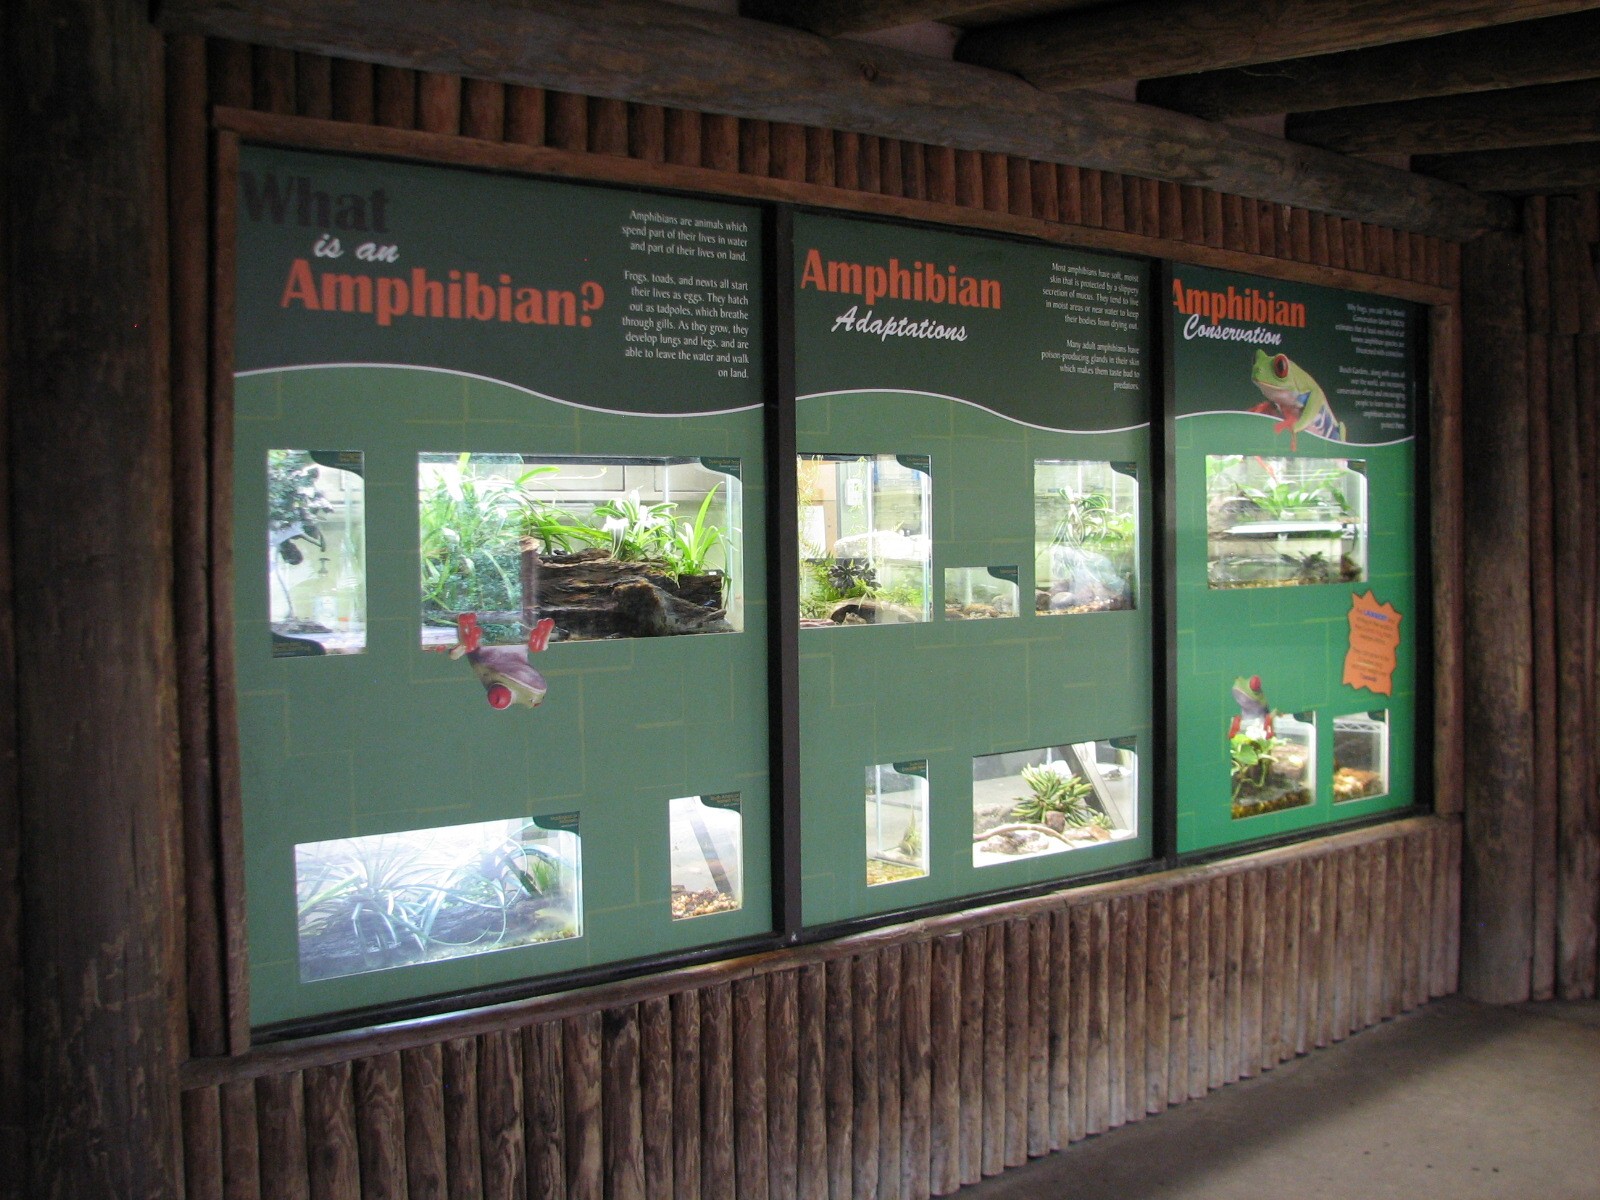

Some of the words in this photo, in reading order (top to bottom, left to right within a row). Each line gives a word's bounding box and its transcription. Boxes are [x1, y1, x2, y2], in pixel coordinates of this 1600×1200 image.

[239, 170, 389, 234] What
[630, 210, 677, 226] Amphibians
[695, 219, 723, 229] animals
[726, 223, 747, 232] which
[622, 226, 646, 237] spend
[649, 229, 665, 239] part
[667, 229, 675, 238] of
[678, 232, 696, 241] their
[699, 233, 715, 243] lives
[719, 235, 725, 243] in
[728, 238, 747, 246] water
[313, 234, 343, 259] is
[356, 241, 399, 263] an
[630, 242, 645, 251] and
[648, 244, 663, 254] part
[667, 245, 675, 253] of
[677, 247, 694, 255] their
[698, 248, 714, 258] lives
[717, 251, 726, 259] on
[729, 252, 747, 261] land.
[625, 271, 648, 284] Frogs,
[652, 274, 676, 285] toads,
[679, 276, 693, 285] and
[696, 279, 717, 288] newts
[720, 279, 728, 288] all
[731, 281, 748, 290] start
[801, 249, 1001, 309] Amphibian
[1052, 263, 1066, 271] Most
[1067, 266, 1097, 276] amphibians
[1098, 269, 1110, 278] have
[1124, 274, 1138, 282] moist
[280, 258, 604, 327] Amphibian?
[1050, 275, 1061, 283] skin
[1063, 277, 1073, 285] that
[1081, 280, 1105, 289] protected
[1107, 283, 1112, 293] by
[631, 287, 650, 297] their
[653, 288, 670, 298] lives
[684, 294, 704, 304] eggs.
[707, 293, 725, 305] They
[728, 296, 748, 305] hatch
[1043, 289, 1067, 297] secretion
[1097, 294, 1108, 305] They
[1173, 279, 1306, 327] Amphibian
[630, 303, 643, 312] out
[657, 305, 693, 316] tadpoles,
[695, 307, 718, 317] which
[720, 309, 748, 319] breathe
[1127, 310, 1139, 320] keep
[622, 317, 654, 328] through
[657, 320, 675, 331] gills.
[679, 321, 689, 330] As
[692, 322, 707, 332] they
[733, 325, 748, 336] they
[831, 306, 968, 341] Adaptations
[1065, 314, 1077, 322] their
[1079, 315, 1096, 325] bodies
[1098, 318, 1110, 326] from
[1111, 320, 1127, 331] drying
[1183, 314, 1282, 345] Conservation
[626, 332, 657, 344] develop
[660, 334, 681, 347] lungs
[684, 336, 698, 345] and
[721, 339, 735, 348] and
[737, 341, 749, 349] are
[1067, 339, 1080, 351] Many
[1097, 343, 1126, 353] amphibians
[1128, 345, 1139, 353] have
[625, 348, 642, 357] able
[645, 349, 653, 358] to
[656, 349, 676, 359] leave
[679, 351, 691, 360] the
[693, 353, 713, 361] water
[716, 353, 730, 362] and
[733, 354, 749, 363] walk
[718, 369, 728, 377] on
[731, 369, 748, 378] land.
[1060, 364, 1075, 372] which
[1095, 367, 1108, 375] them
[1123, 369, 1133, 377] bad
